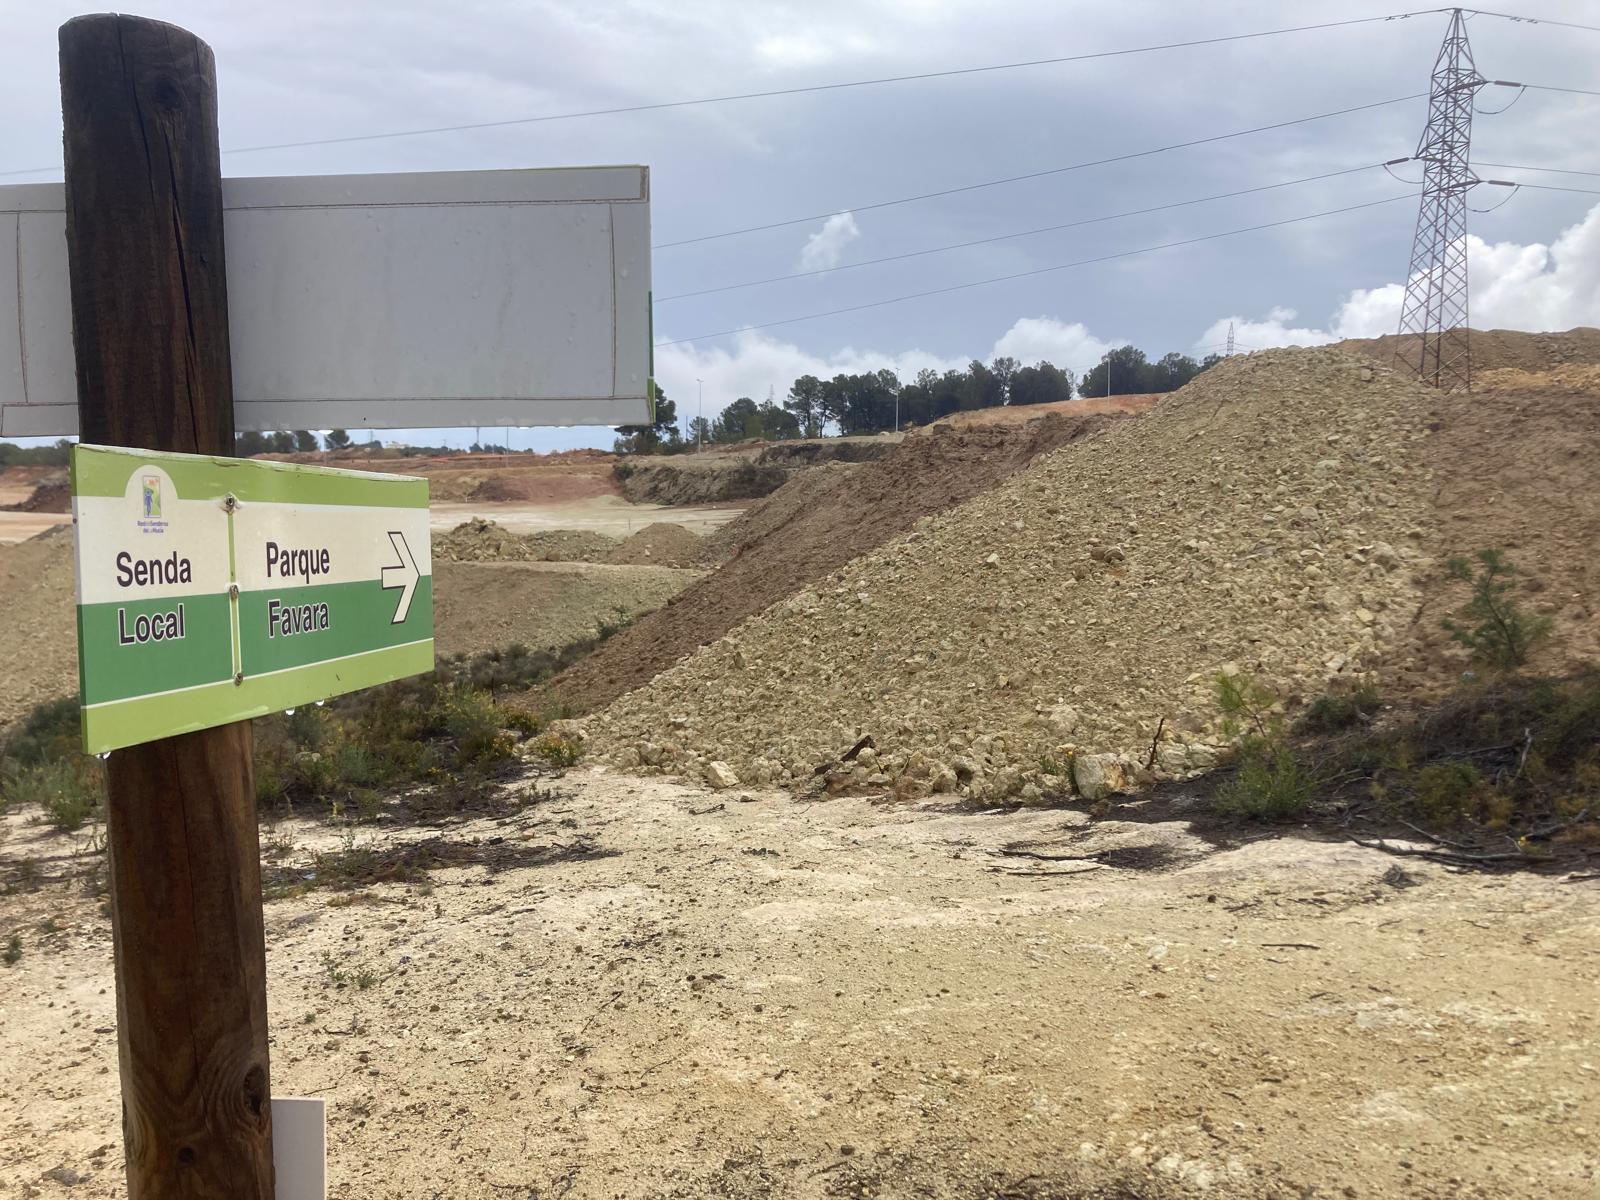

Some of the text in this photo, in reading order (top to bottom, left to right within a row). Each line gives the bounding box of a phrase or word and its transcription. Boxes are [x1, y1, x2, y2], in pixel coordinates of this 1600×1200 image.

[116, 550, 192, 587] Senda
[266, 541, 330, 584] Parque
[117, 602, 186, 646] Local
[267, 598, 330, 639] Favara
